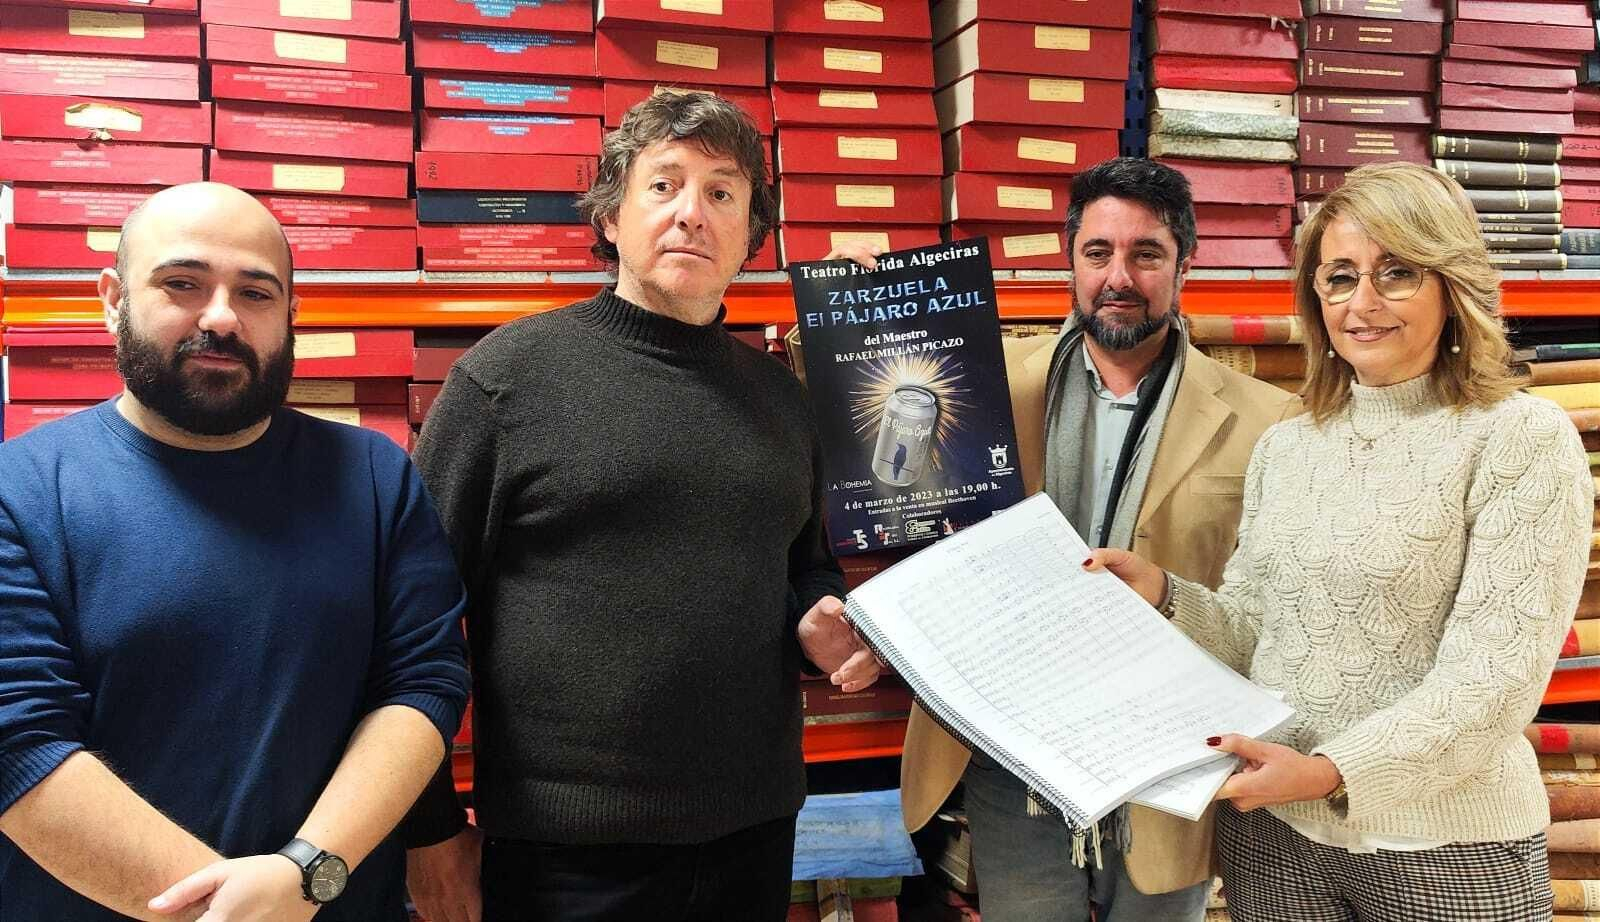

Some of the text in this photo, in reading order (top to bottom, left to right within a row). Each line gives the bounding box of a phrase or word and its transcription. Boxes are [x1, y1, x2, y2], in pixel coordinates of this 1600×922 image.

[800, 265, 846, 279] Teatro
[909, 246, 979, 267] Algeciras
[828, 276, 948, 305] ZARZUELA
[806, 291, 987, 328] El PÁJARO AZUL
[835, 337, 964, 363] RAFAEL MILLÁN PICAZO
[863, 329, 928, 346] del Maestro
[841, 479, 873, 490] BOHEMIA
[844, 482, 1001, 511] 4 de marzo de 2023 a las 19,00 h.
